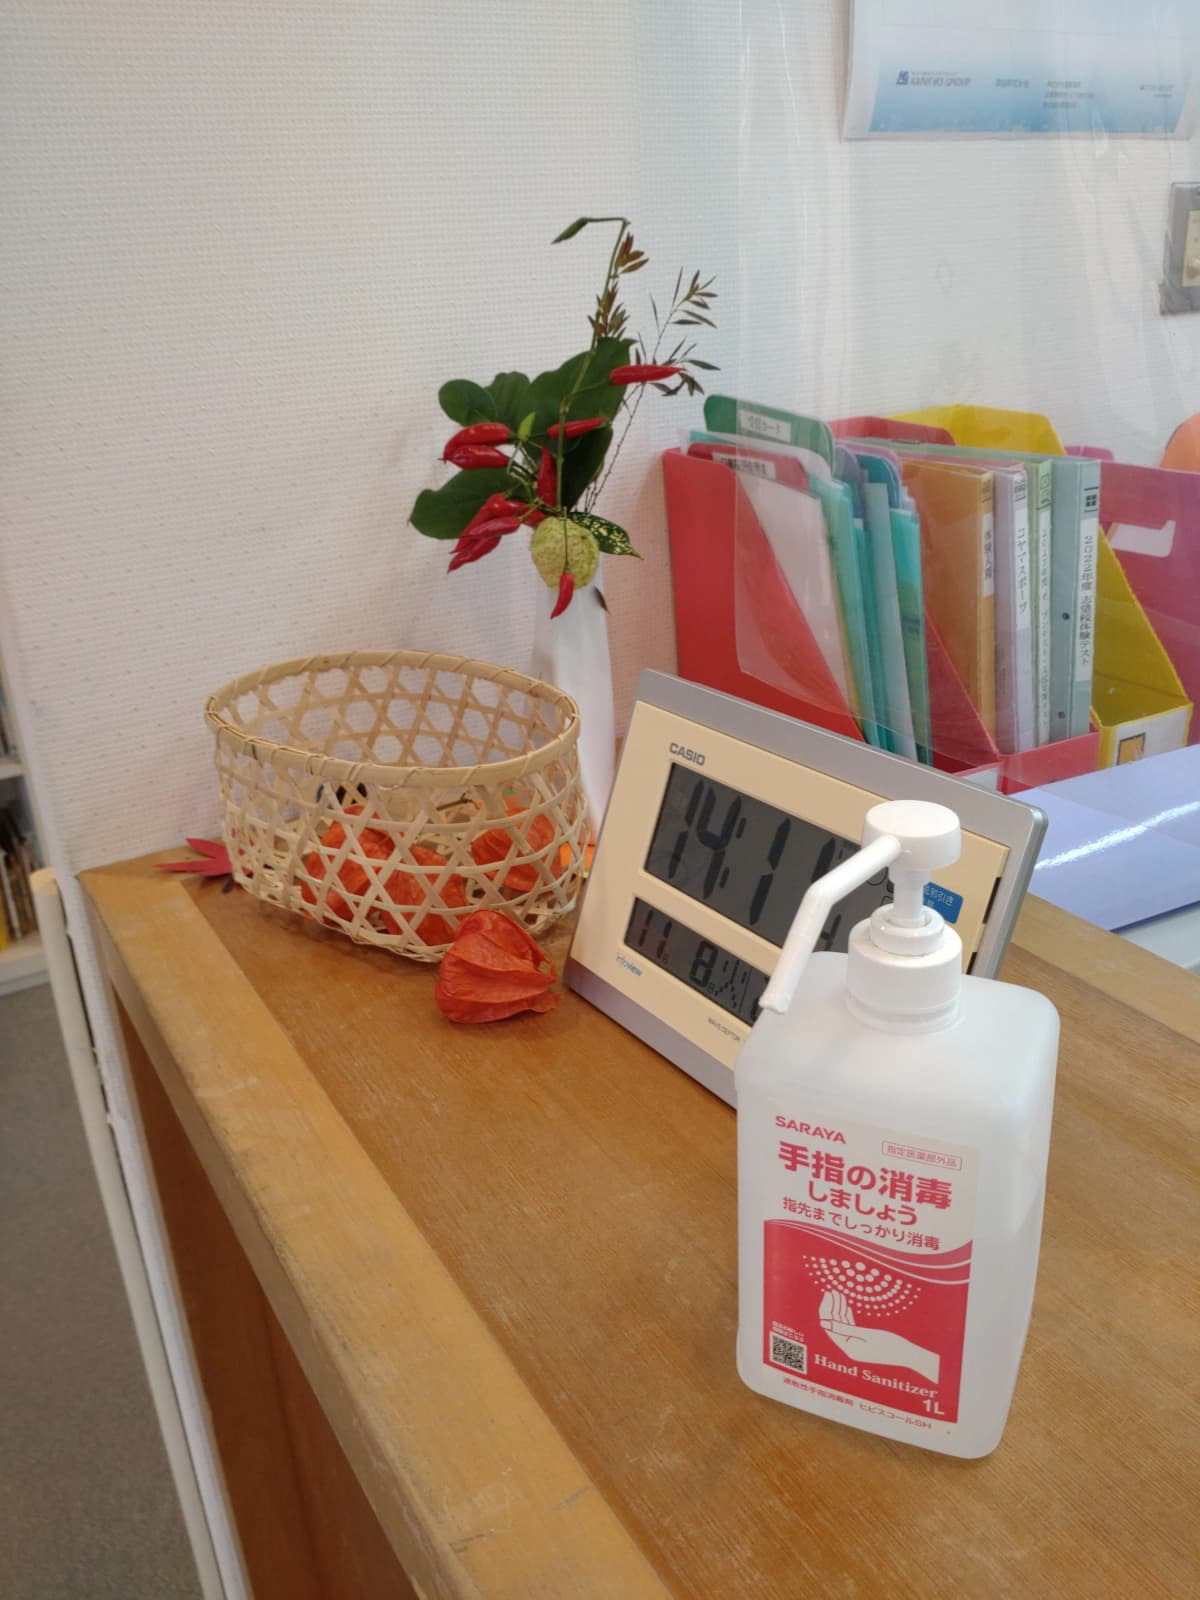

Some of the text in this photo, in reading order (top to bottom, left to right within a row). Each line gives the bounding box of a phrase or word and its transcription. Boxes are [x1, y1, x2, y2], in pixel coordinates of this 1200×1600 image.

[669, 742, 706, 766] CASIO
[775, 1115, 846, 1145] SARAYA
[778, 1140, 952, 1210] 手指の消毒
[887, 1144, 958, 1168] 指定医薬部外品
[808, 1180, 918, 1226] しましょう
[783, 1196, 941, 1251] 指先までしっかり消毒
[814, 1353, 938, 1399] Hand Sanitizer
[923, 1399, 945, 1416] 1L
